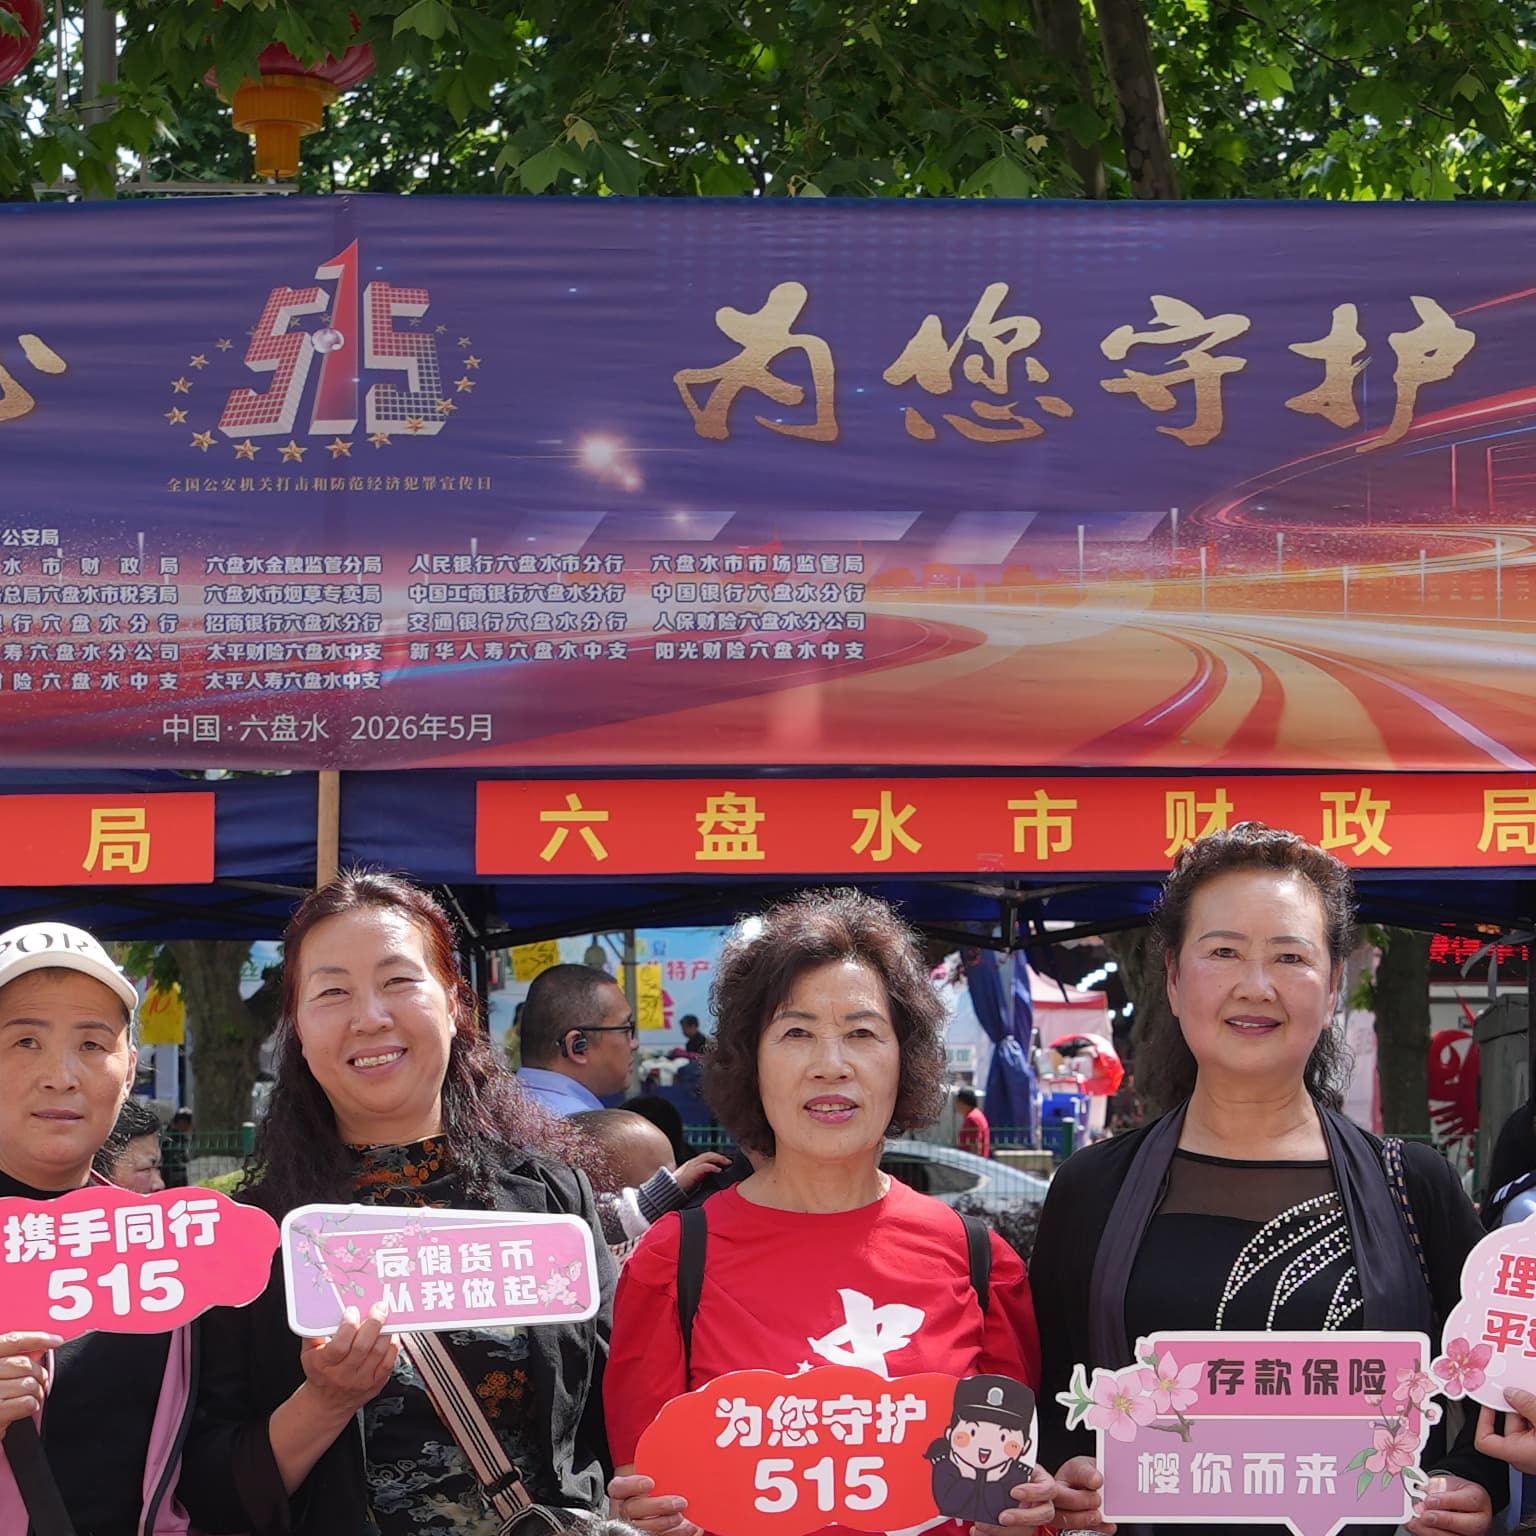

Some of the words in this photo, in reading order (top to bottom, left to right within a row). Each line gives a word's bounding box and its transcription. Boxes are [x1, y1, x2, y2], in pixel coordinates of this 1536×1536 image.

[218, 238, 447, 437] 515
[671, 280, 1477, 454] 为您守护
[167, 475, 493, 493] 全国公安机关打击和防范经济犯罪宣传日
[206, 555, 382, 575] 六盘水金融监管分局
[409, 554, 624, 574] 人民银行六盘水市分行
[651, 554, 864, 573] 六盘水市市场监管局
[205, 585, 381, 604] 六盘水市烟草专卖局
[409, 583, 624, 603] 中国工商银行六盘水分行
[652, 583, 865, 602] 中国银行六盘水分行
[205, 614, 381, 633] 招商银行六盘水分行
[409, 612, 627, 632] 交通银行六盘水分行
[654, 612, 865, 631] 人保财险六盘水分公司
[207, 643, 382, 662] 太平财险六盘水中支
[410, 641, 627, 660] 新华人寿六盘水中支
[655, 641, 864, 660] 阳光财险六盘水中支
[206, 672, 382, 691] 太平人寿六盘水中支
[163, 714, 329, 743] 中国·六盘水
[350, 714, 493, 742] 2026年5月
[3, 1199, 222, 1263] 携手同行
[375, 1239, 536, 1280] 反假货币
[48, 1259, 186, 1321] 515
[380, 1278, 539, 1314] 从我做起
[1206, 1358, 1390, 1398] 存款保险
[714, 1396, 929, 1448] 为您守护
[752, 1457, 890, 1514] 515
[1137, 1451, 1339, 1496] 樱你而来
